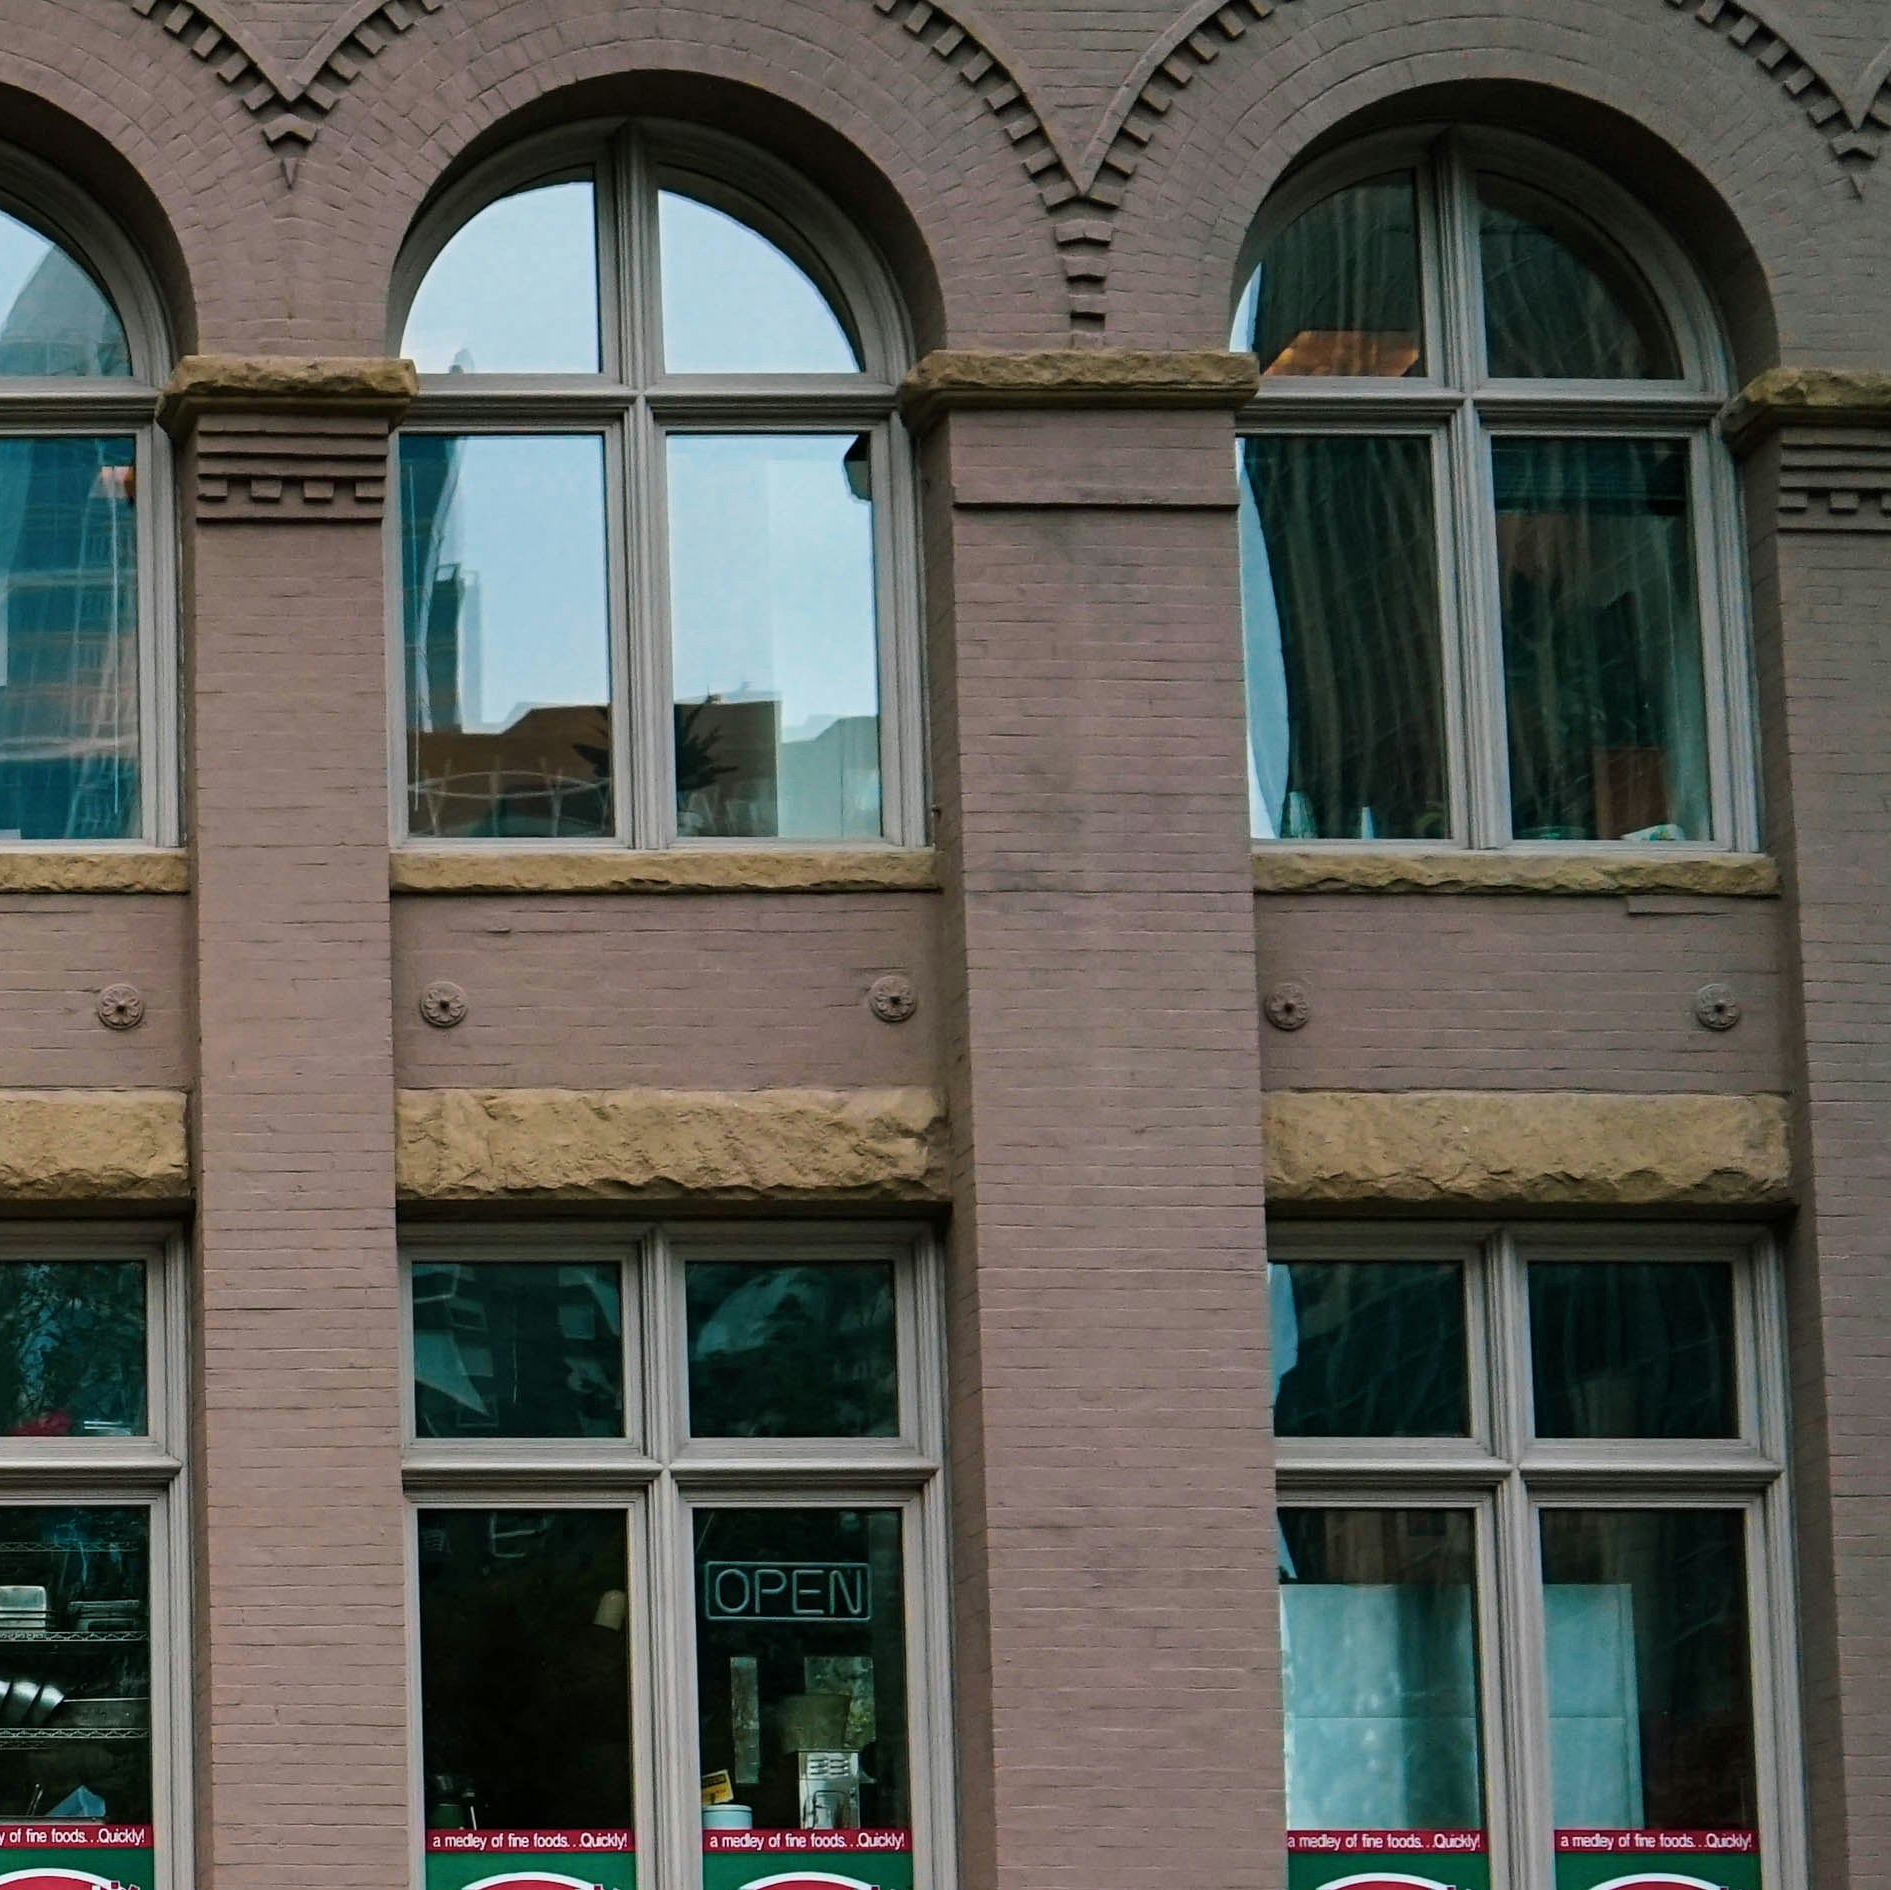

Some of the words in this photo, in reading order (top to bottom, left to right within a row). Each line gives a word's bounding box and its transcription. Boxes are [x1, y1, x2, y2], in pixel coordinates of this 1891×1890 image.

[714, 1566, 864, 1618] OPEN
[9, 1828, 22, 1843] of
[26, 1828, 47, 1843] fine
[432, 1836, 441, 1848] a
[445, 1833, 487, 1851] medley
[491, 1833, 504, 1848] of
[508, 1833, 530, 1848] fine
[710, 1836, 718, 1848] a
[722, 1833, 764, 1851] medley
[769, 1833, 781, 1848] of
[785, 1833, 807, 1848] fine
[1287, 1836, 1296, 1848] a
[1299, 1834, 1342, 1851] medley
[1345, 1834, 1358, 1849] of
[1362, 1834, 1384, 1849] fine
[1560, 1836, 1569, 1848] a
[1572, 1833, 1614, 1851] medley
[1619, 1833, 1631, 1848] of
[1634, 1833, 1656, 1848] fine
